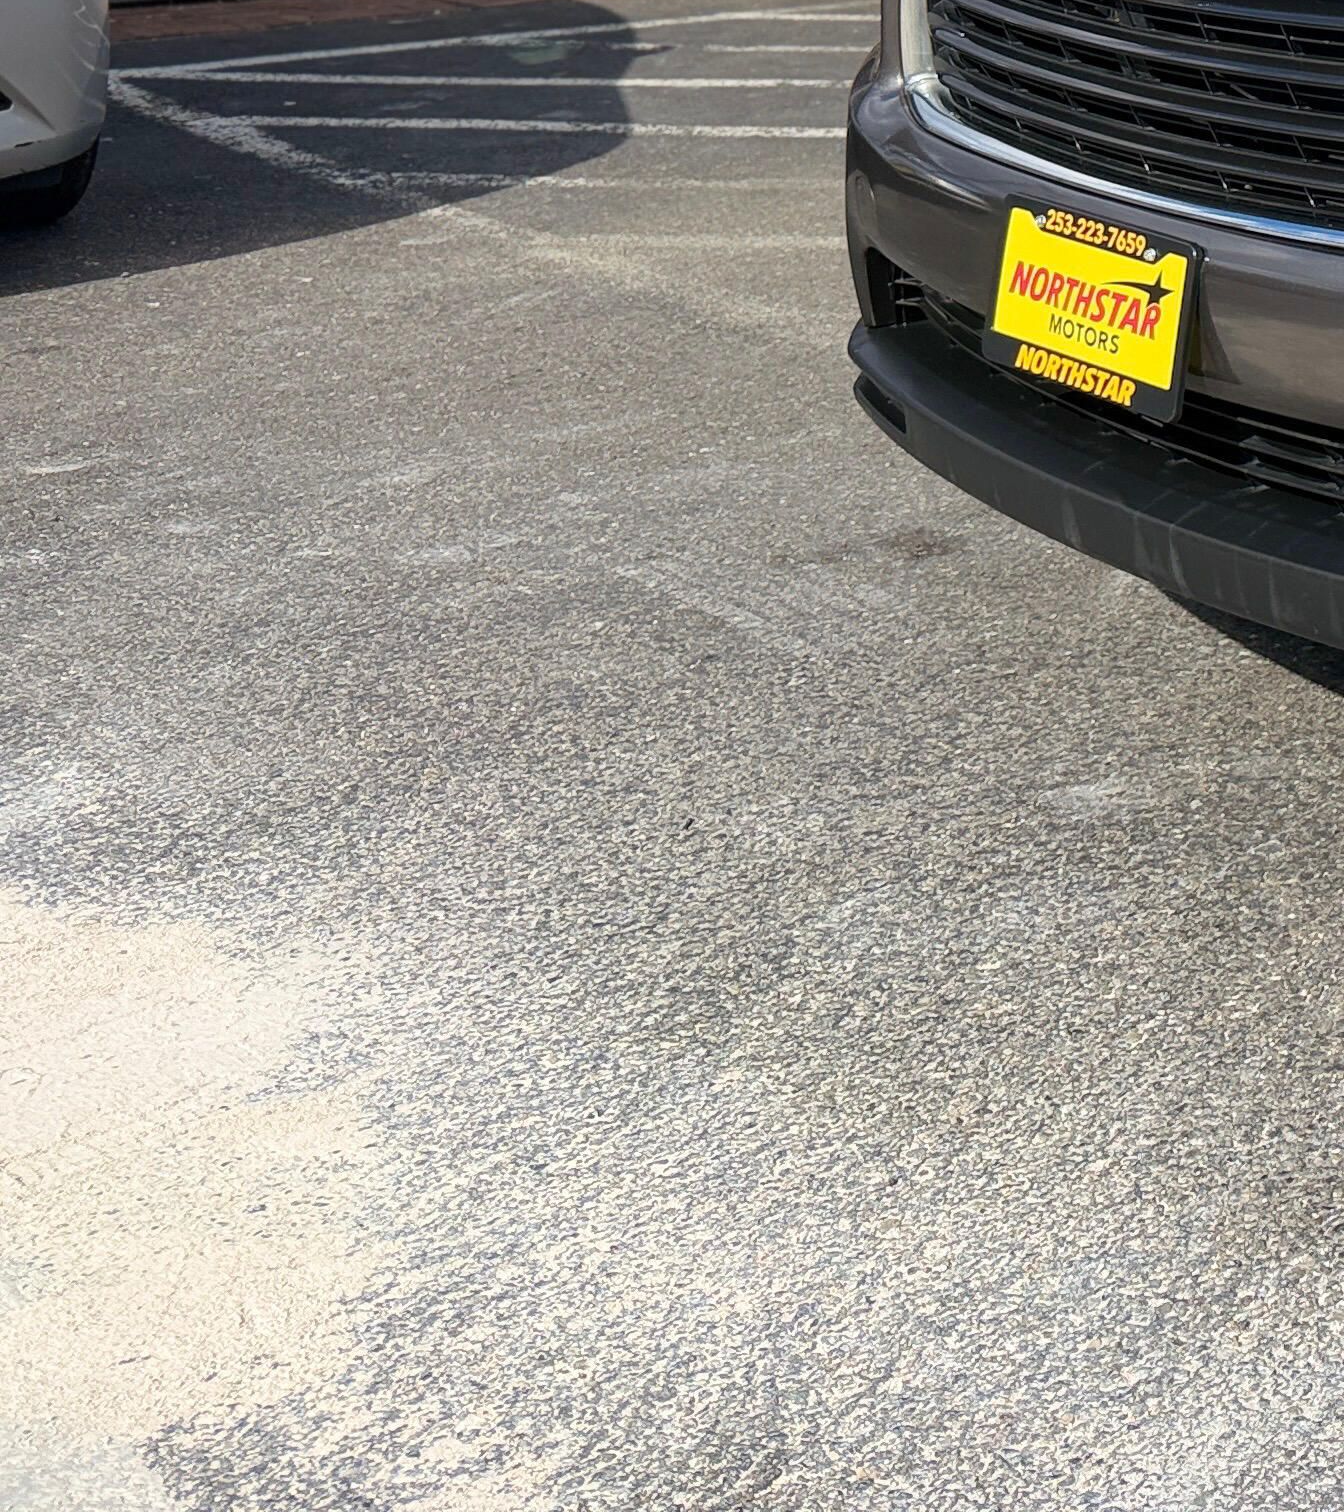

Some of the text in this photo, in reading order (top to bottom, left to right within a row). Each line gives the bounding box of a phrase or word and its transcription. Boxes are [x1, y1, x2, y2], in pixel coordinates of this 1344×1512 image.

[1045, 208, 1147, 257] 253-223-7659
[1009, 261, 1162, 341] NORTHSTAR
[1049, 313, 1120, 355] MOTORS
[1014, 343, 1137, 407] NORTHSTAR
